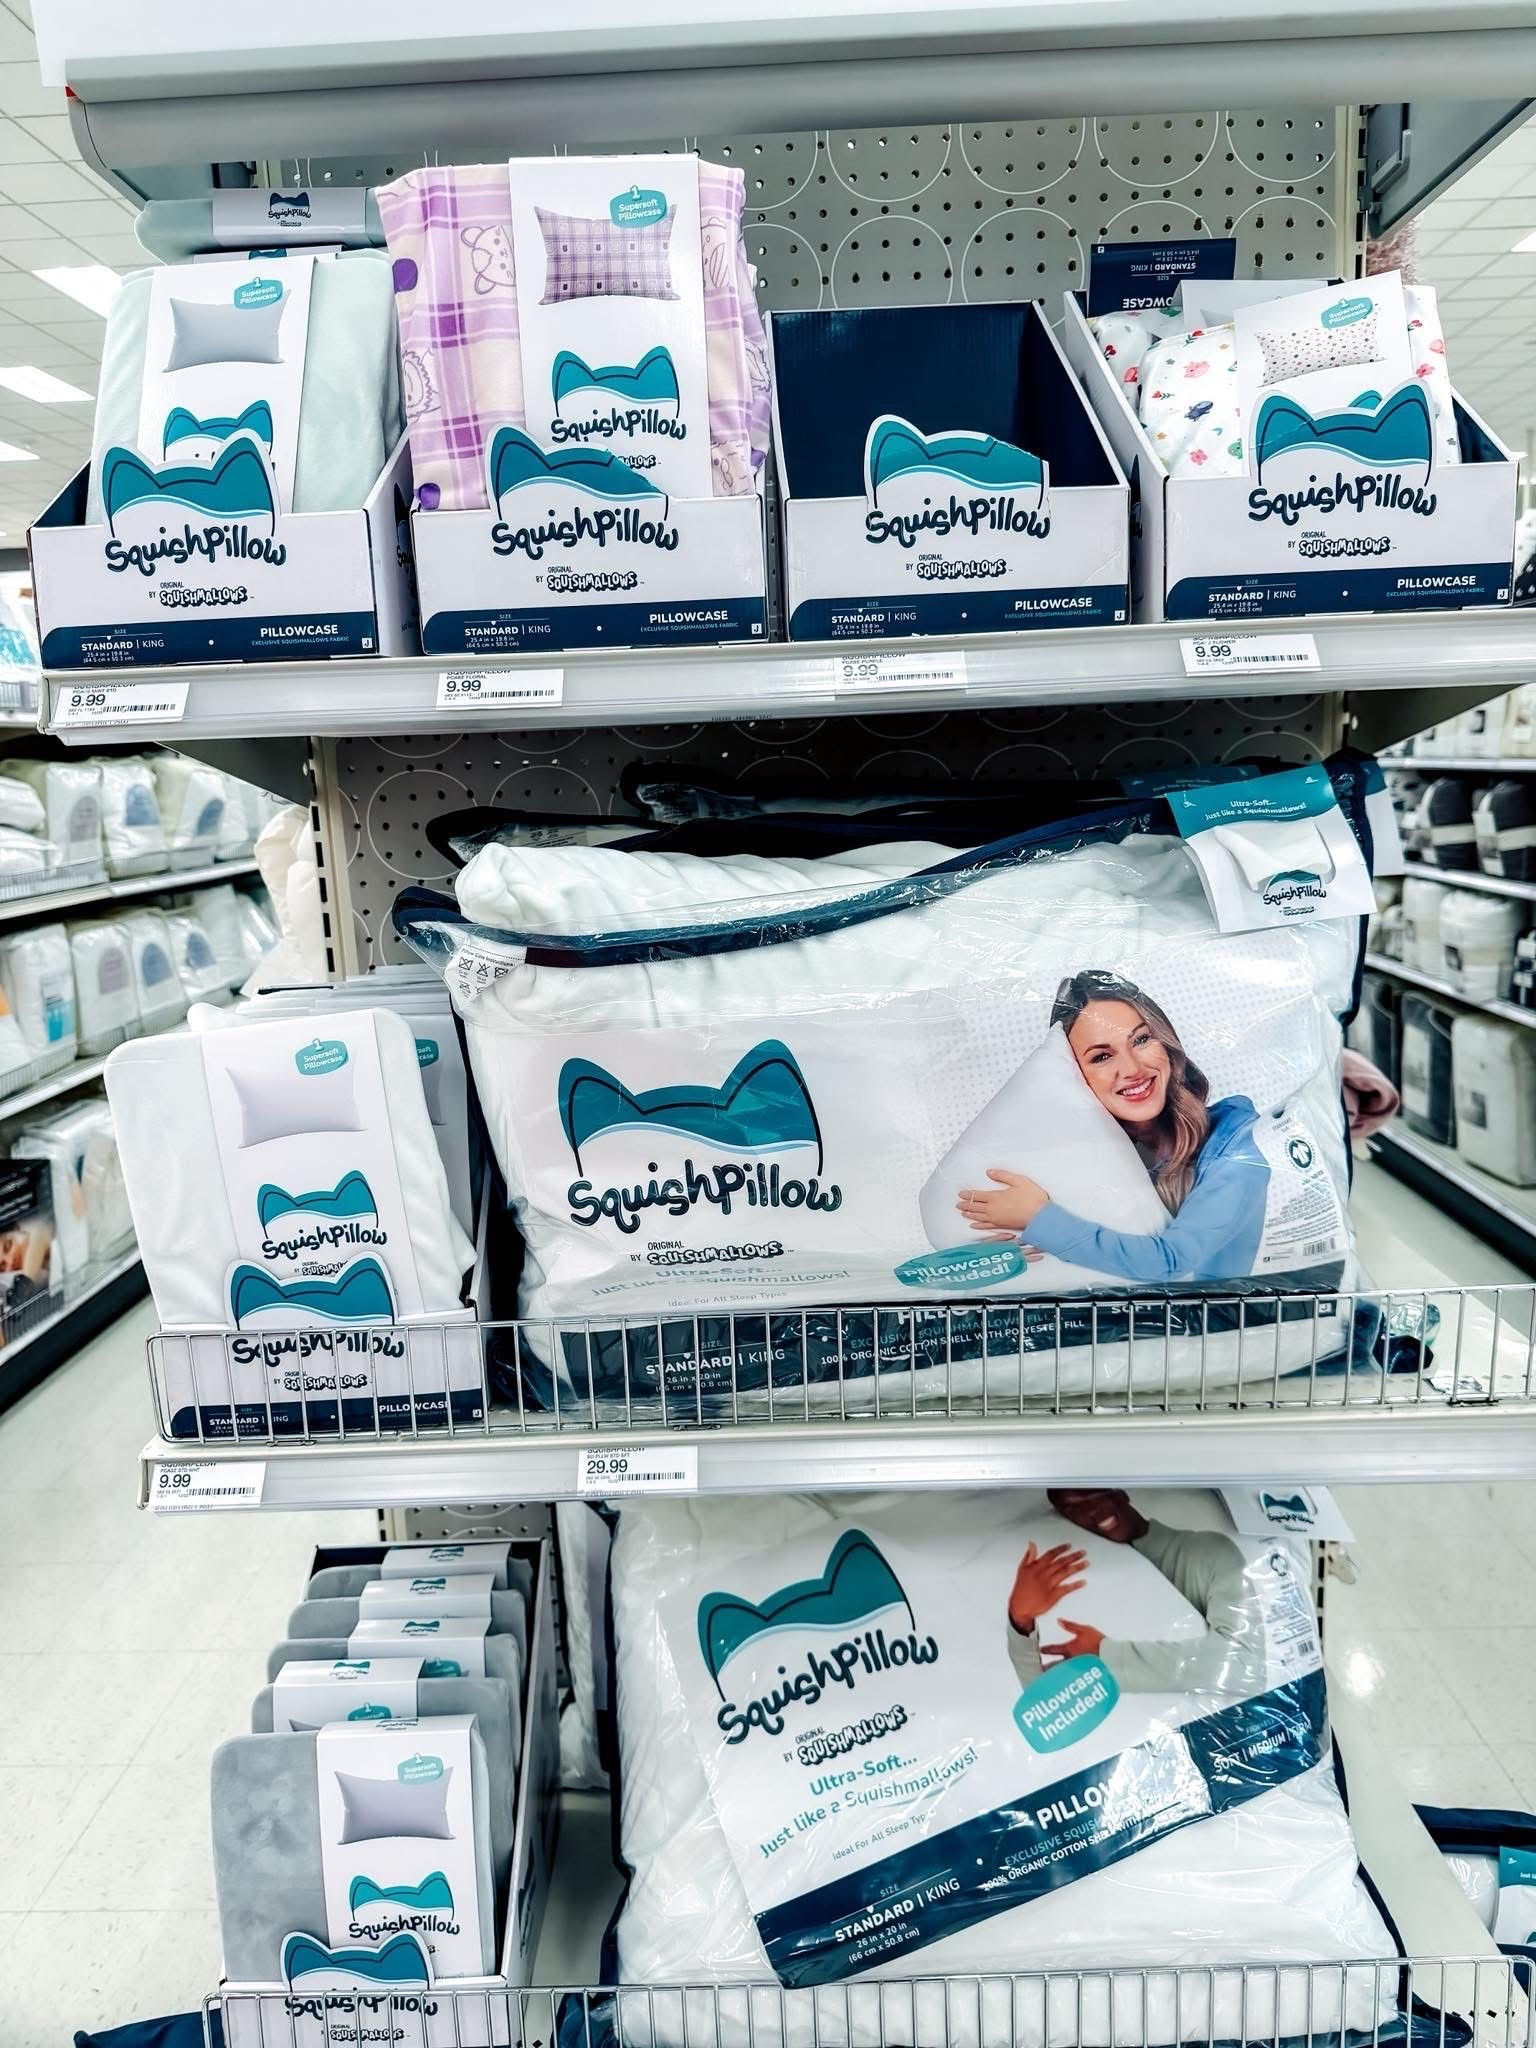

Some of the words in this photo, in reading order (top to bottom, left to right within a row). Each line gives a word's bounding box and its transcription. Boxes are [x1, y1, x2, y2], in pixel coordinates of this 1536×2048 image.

[631, 186, 641, 199] 1
[618, 199, 658, 212] Supersoft
[268, 208, 312, 220] SquishPillow
[618, 208, 662, 221] Pillowcase
[1154, 262, 1197, 271] STANDARD
[253, 277, 262, 288] 1
[240, 292, 278, 305] Pillowcase
[241, 286, 276, 298] Supersoft
[551, 407, 687, 443] SquishPillow
[1248, 472, 1437, 527] SquishPillow
[866, 495, 1051, 548] SquishPillow
[491, 508, 680, 559] SquishPillow
[1301, 531, 1327, 539] ORIGINAL
[105, 524, 287, 577] SquishPillow
[1287, 541, 1296, 549] BY
[1299, 536, 1391, 558] SQUISHMALLOWS
[918, 553, 943, 561] ORIGINAL
[905, 563, 913, 571] BY
[917, 559, 1006, 580] SQUISHMALLOWS
[159, 581, 184, 589] ORIGINAL
[536, 575, 543, 583] BY
[547, 571, 638, 593] SQUISHMALLOWS
[1397, 575, 1477, 589] PILLOWCASE
[149, 591, 156, 599] BY
[159, 586, 248, 608] SQUISHMALLOWS
[1208, 591, 1264, 602] STANDARD
[1273, 589, 1296, 599] KING
[1015, 597, 1092, 611] PILLOWCASE
[649, 610, 728, 624] PILLOWCASE
[831, 614, 885, 624] STANDARD
[894, 612, 917, 621] KING
[260, 624, 338, 638] PILLOWCASE
[465, 626, 518, 636] STANDARD
[528, 625, 551, 634] KING
[81, 641, 134, 651] STANDARD
[142, 639, 165, 648] KING
[1195, 645, 1232, 658] 9.99
[843, 663, 879, 677] 9.99
[446, 680, 482, 693] 9.99
[71, 694, 106, 707] 9.99
[1263, 885, 1327, 905] SquishPillow
[313, 1039, 323, 1050] 1
[303, 1048, 339, 1063] Supersoft
[303, 1055, 343, 1070] Pillowcase
[568, 1159, 843, 1234] SquishPillow
[262, 1223, 388, 1260] SquishPillow
[647, 1241, 684, 1250] ORIGINAL
[630, 1254, 641, 1263] BY
[647, 1241, 785, 1265] SQUISHMALLOWS
[903, 1251, 1015, 1277] Pillowcase
[592, 1284, 626, 1297] Just
[1064, 1319, 1085, 1329] FILL
[701, 1340, 722, 1349] SIZE
[748, 1348, 785, 1364] KING
[667, 1376, 678, 1384] 26
[680, 1374, 688, 1382] in
[587, 1459, 628, 1474] 29.99
[159, 1473, 191, 1488] 9.99
[718, 1629, 939, 1744] SquishPillow
[1021, 1666, 1103, 1729] Pillowcase
[1038, 1682, 1109, 1741] Included!
[783, 1752, 794, 1763] BY
[797, 1704, 908, 1766] SQUISHMALLOWS
[794, 1725, 825, 1744] ORIGINAL
[809, 1754, 918, 1796] Ultra-Soft...
[758, 1828, 794, 1860] Just
[793, 1807, 827, 1832] like
[831, 1801, 841, 1813] a
[844, 1746, 979, 1807] Squishmallows!
[832, 1846, 854, 1861] Ideal
[855, 1839, 870, 1851] For
[871, 1831, 884, 1844] All
[885, 1822, 909, 1838] Sleep
[1004, 1834, 1063, 1866] EXCLUSIVE
[1008, 1855, 1050, 1881] ORGANIC
[1051, 1838, 1088, 1863] COTTON
[880, 1883, 901, 1898] SIZE
[834, 1899, 914, 1942] STANDARD
[925, 1877, 961, 1902] KING
[349, 1914, 460, 1940] SquishPillow
[856, 1938, 869, 1948] 26
[869, 1935, 878, 1944] in
[886, 1925, 897, 1936] 20
[899, 1921, 907, 1930] in
[848, 1953, 863, 1964] (66
[864, 1946, 877, 1956] cm
[884, 1934, 904, 1948] 50.8
[904, 1927, 920, 1940] cm)
